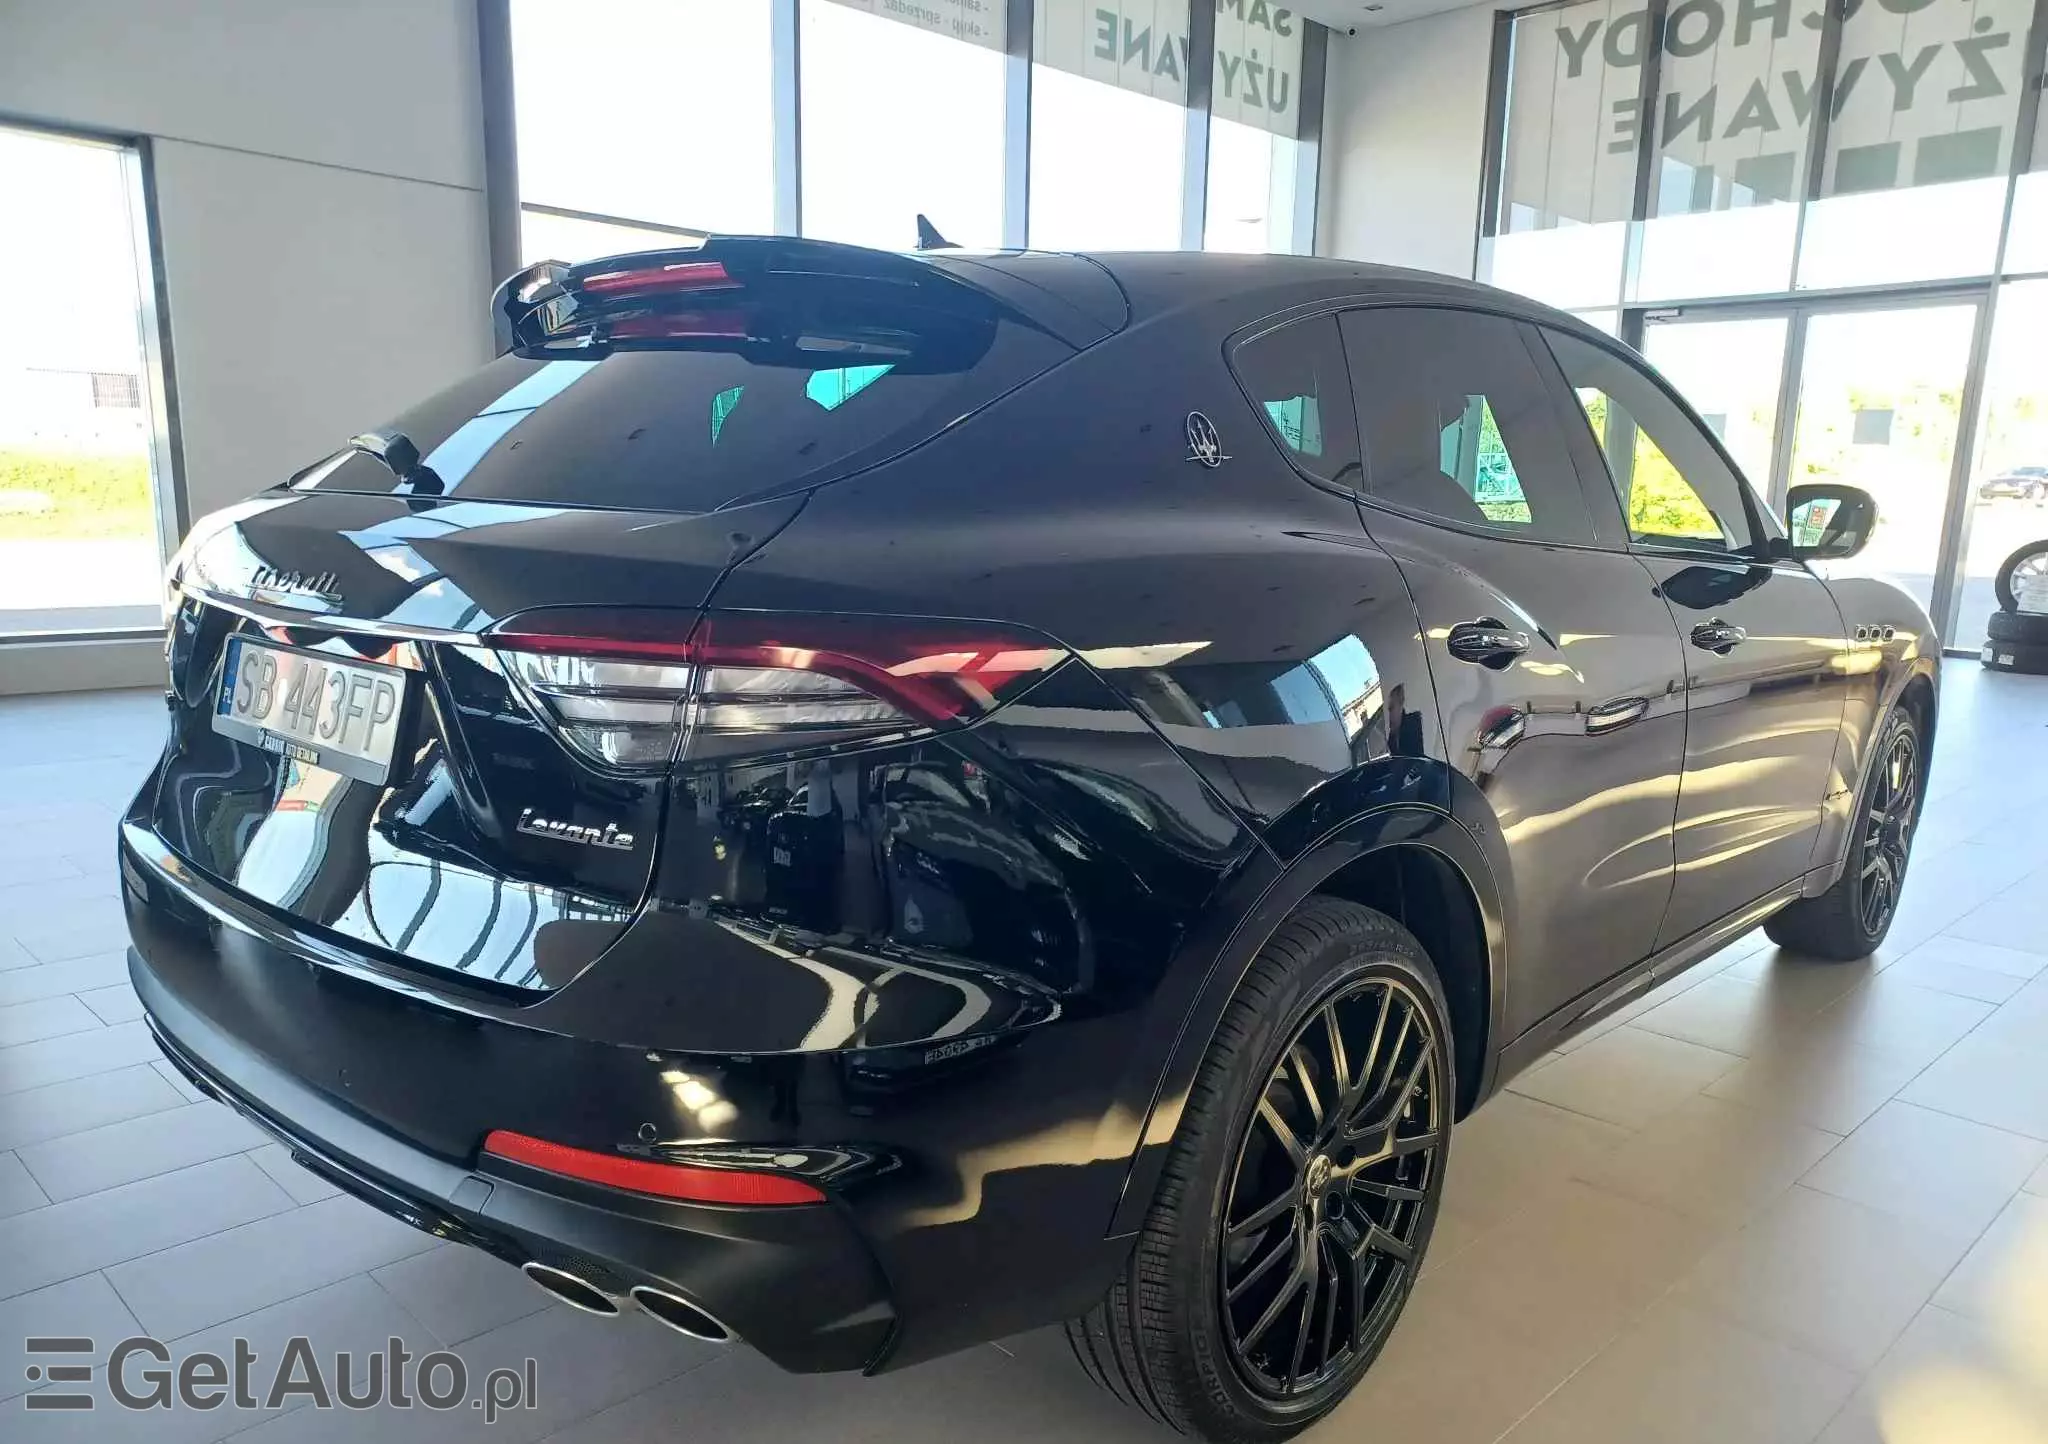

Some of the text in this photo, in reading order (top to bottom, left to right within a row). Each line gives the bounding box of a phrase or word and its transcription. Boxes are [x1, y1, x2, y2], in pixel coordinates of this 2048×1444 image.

[223, 686, 232, 704] PL
[237, 650, 396, 752] SB 443FP
[516, 807, 634, 851] Levante
